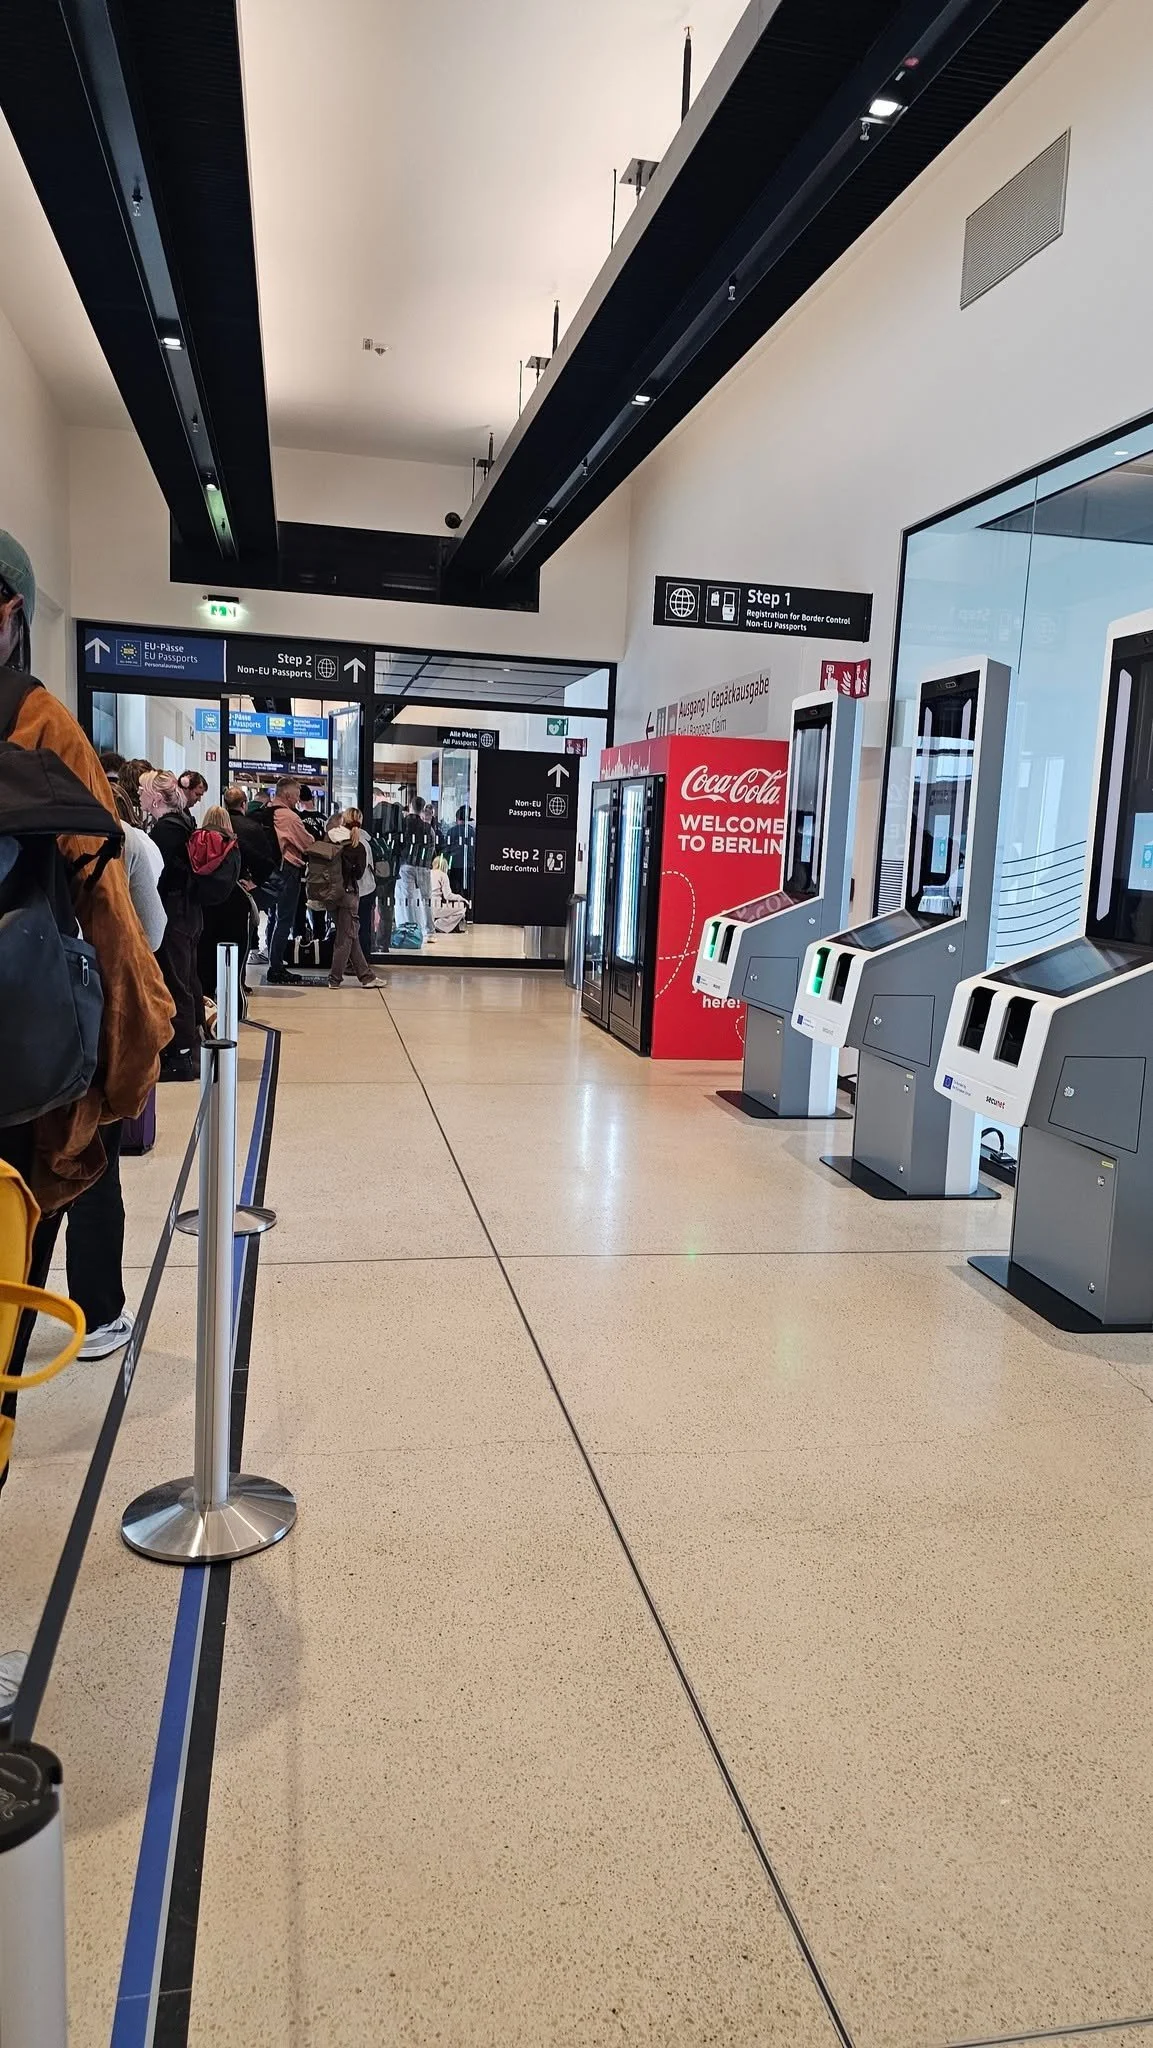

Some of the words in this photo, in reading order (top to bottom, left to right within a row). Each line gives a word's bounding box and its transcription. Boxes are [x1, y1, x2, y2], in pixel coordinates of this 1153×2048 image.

[747, 589, 780, 609] Step
[784, 592, 791, 606] 1
[746, 609, 788, 620] Registration
[789, 612, 800, 621] for
[801, 613, 825, 623] Border
[825, 615, 851, 625] Control
[745, 619, 773, 629] Non-EU
[774, 621, 807, 632] Passports
[144, 641, 184, 653] EU-Pässe
[144, 652, 156, 661] EU
[158, 653, 198, 664] Passports
[277, 653, 303, 667] Step
[304, 655, 312, 666] 2
[237, 665, 270, 676] Non-EU
[272, 668, 312, 679] Passports
[679, 697, 706, 721] Ausgang
[711, 673, 770, 712] Gepäckausgabe
[461, 731, 478, 739] Pässe
[451, 738, 478, 747] Passports
[681, 765, 787, 805] Coca-Cola
[515, 799, 541, 808] Non-EU
[508, 809, 541, 818] Passports
[679, 814, 785, 835] WELCOME
[677, 834, 706, 852] TO
[711, 836, 784, 855] BERLIN
[502, 848, 530, 861] Step
[532, 849, 540, 860] 2
[490, 863, 514, 873] Border
[515, 864, 540, 874] Control
[702, 995, 741, 1009] here!
